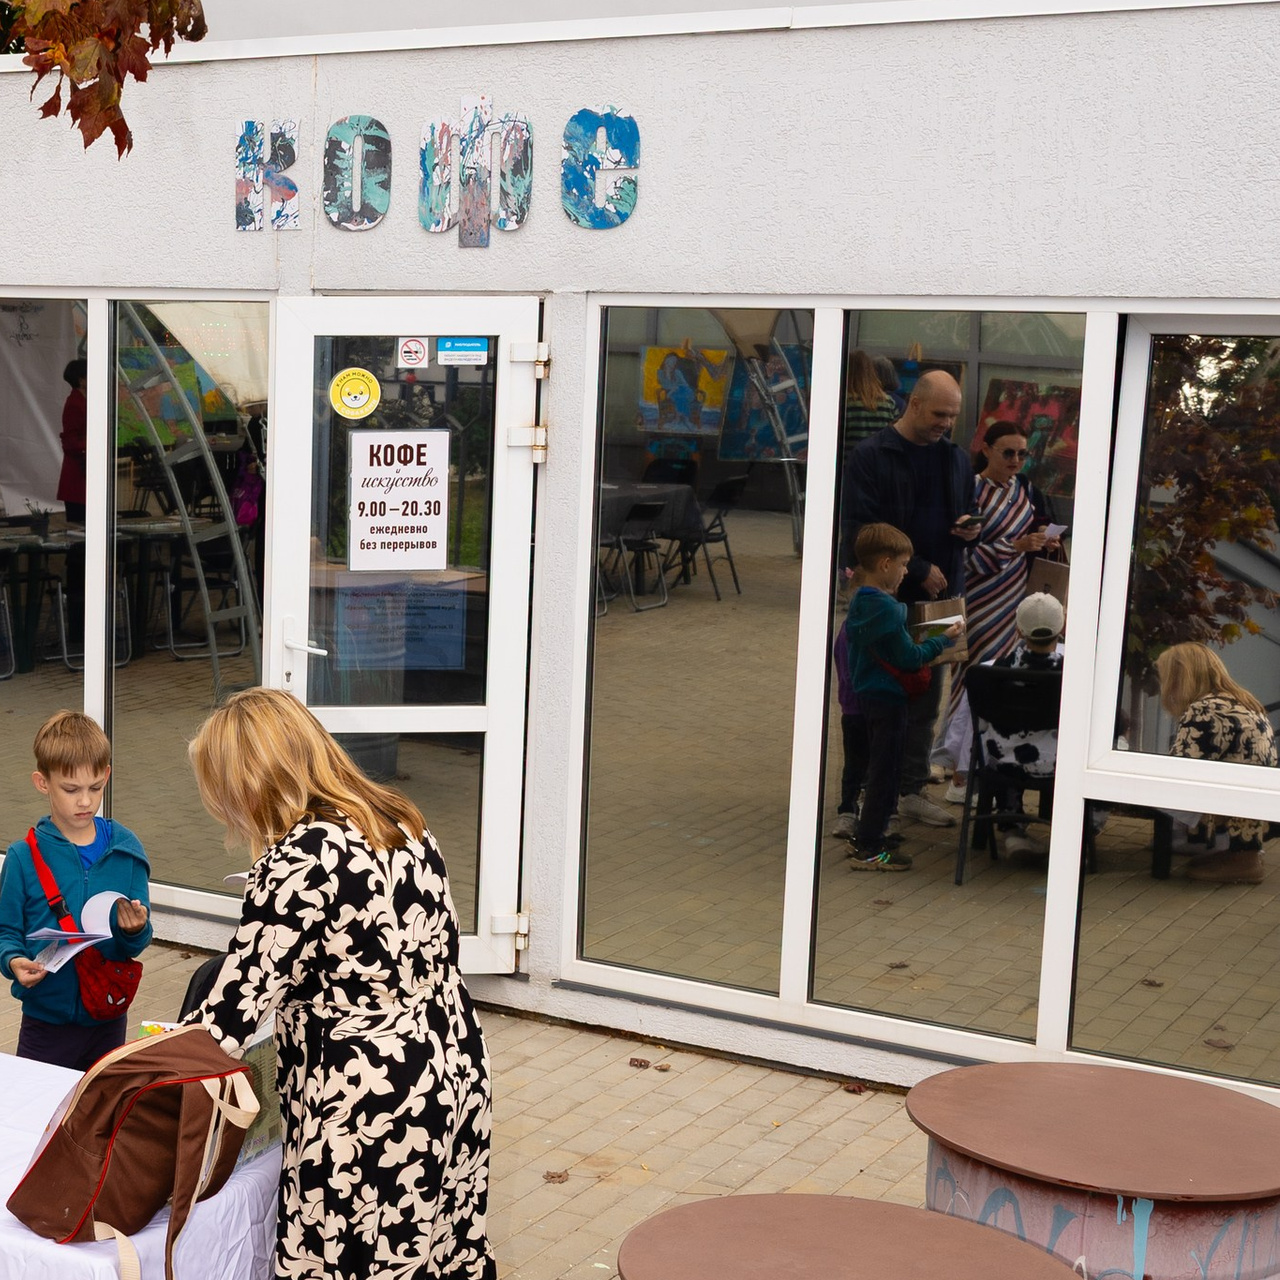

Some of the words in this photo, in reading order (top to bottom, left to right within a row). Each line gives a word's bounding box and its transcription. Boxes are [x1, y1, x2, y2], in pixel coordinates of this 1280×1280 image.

[369, 443, 428, 467] КОФЕ
[361, 467, 439, 494] искусство
[369, 525, 428, 535] ежедневно
[359, 538, 377, 550] без
[380, 540, 437, 552] перерывов
